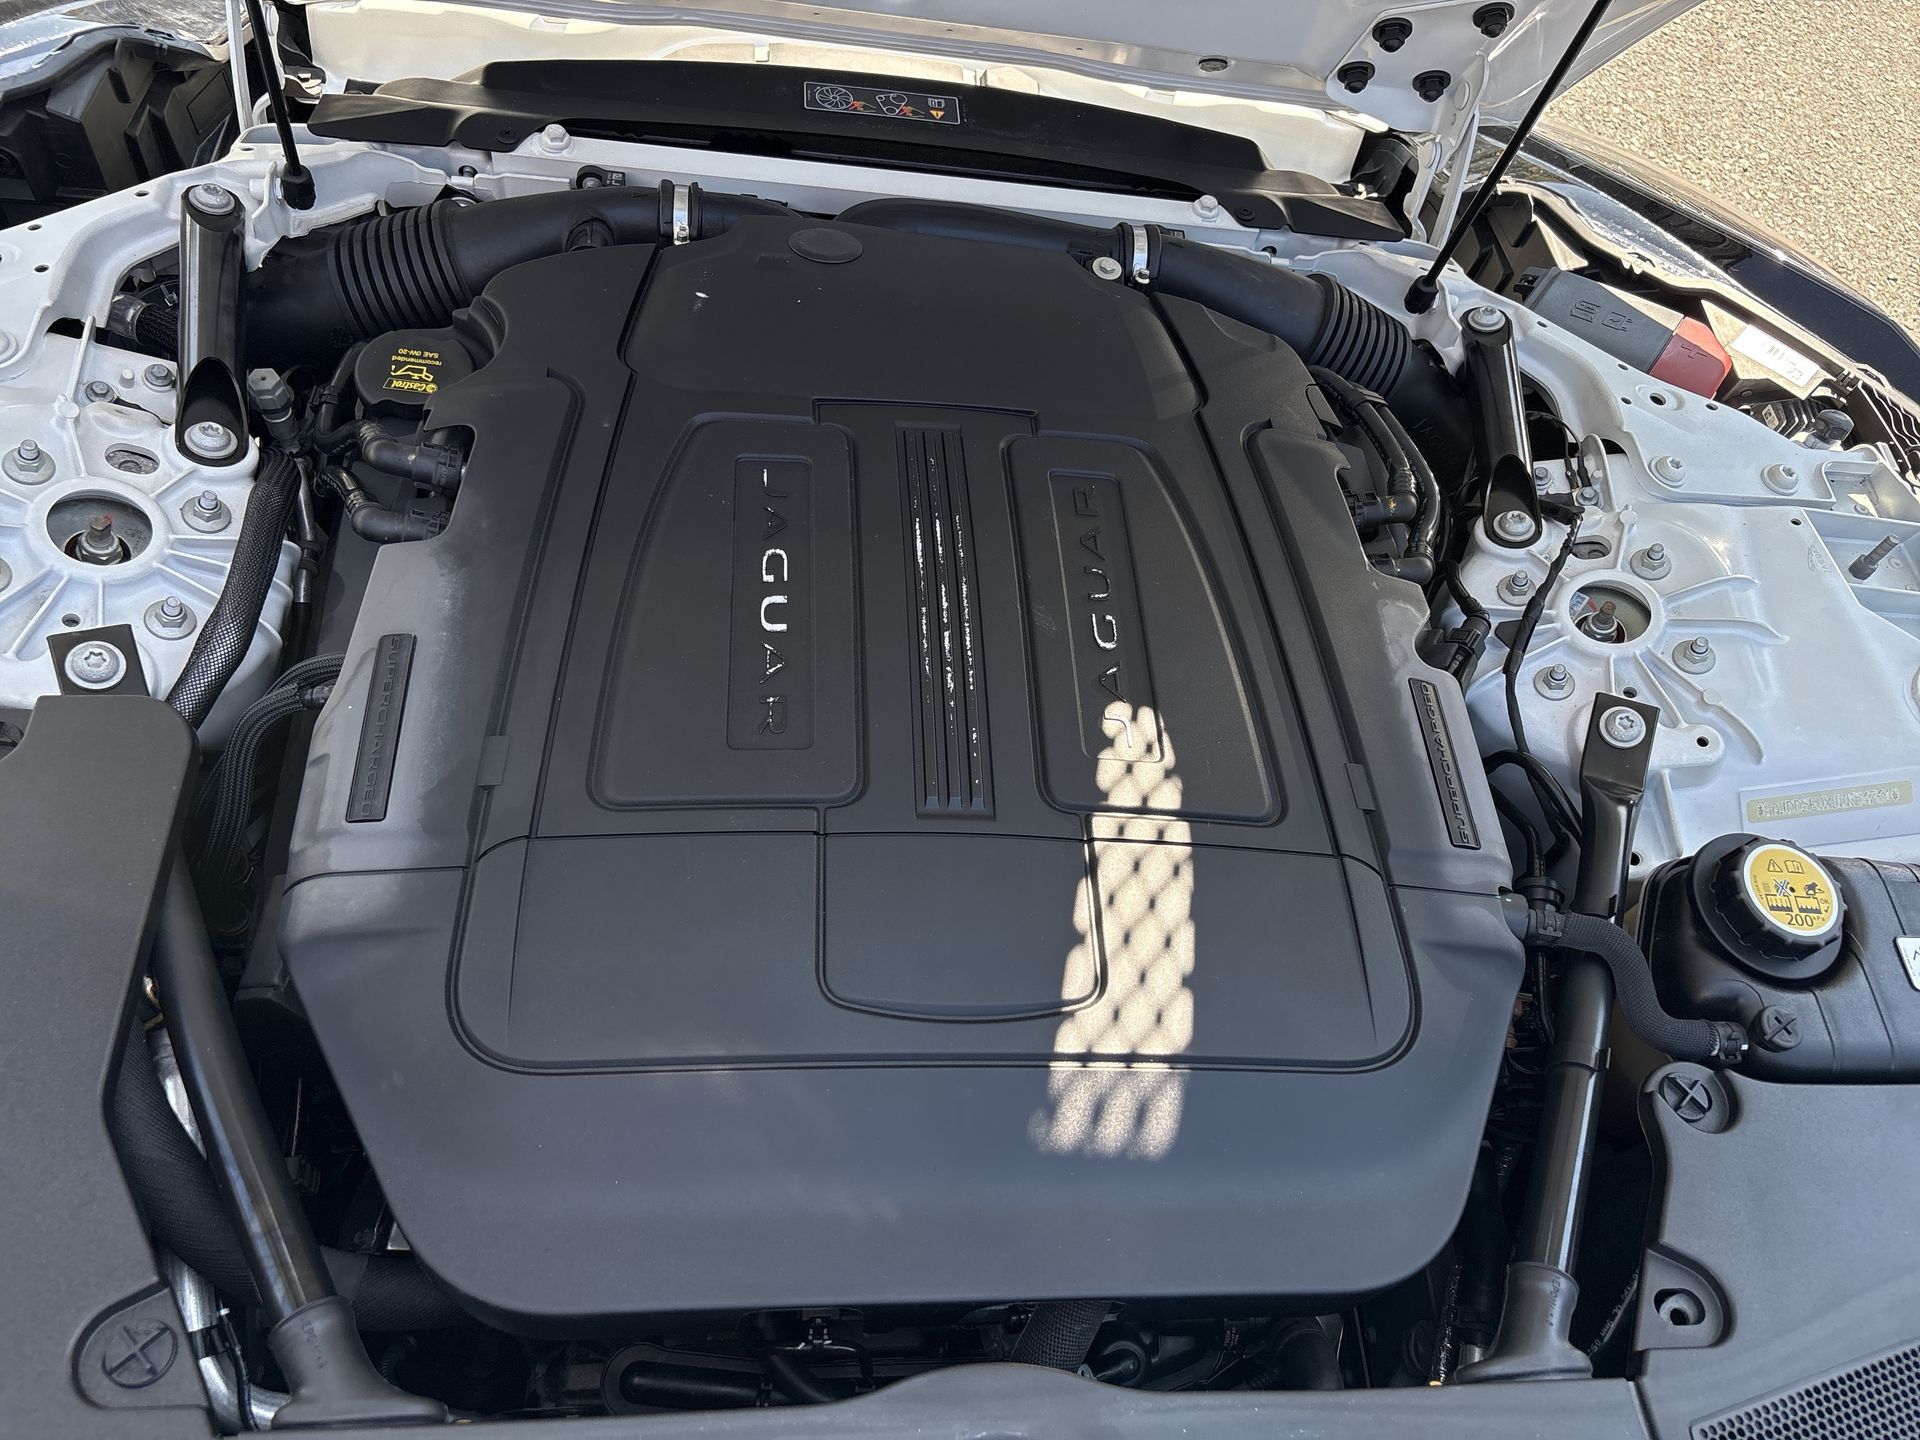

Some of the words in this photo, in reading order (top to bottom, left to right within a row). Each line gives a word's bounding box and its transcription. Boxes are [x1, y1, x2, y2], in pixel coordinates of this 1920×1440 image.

[398, 348, 422, 356] 0W-20
[423, 351, 440, 359] SAE
[391, 355, 442, 366] recommended
[391, 380, 426, 392] Castrol
[760, 467, 790, 736] JAGUAR
[1072, 484, 1133, 749] JAGUAR
[360, 637, 402, 817] SUPERCHARGED
[1420, 682, 1471, 845] SUPERCHARGED
[1785, 913, 1814, 927] 200
